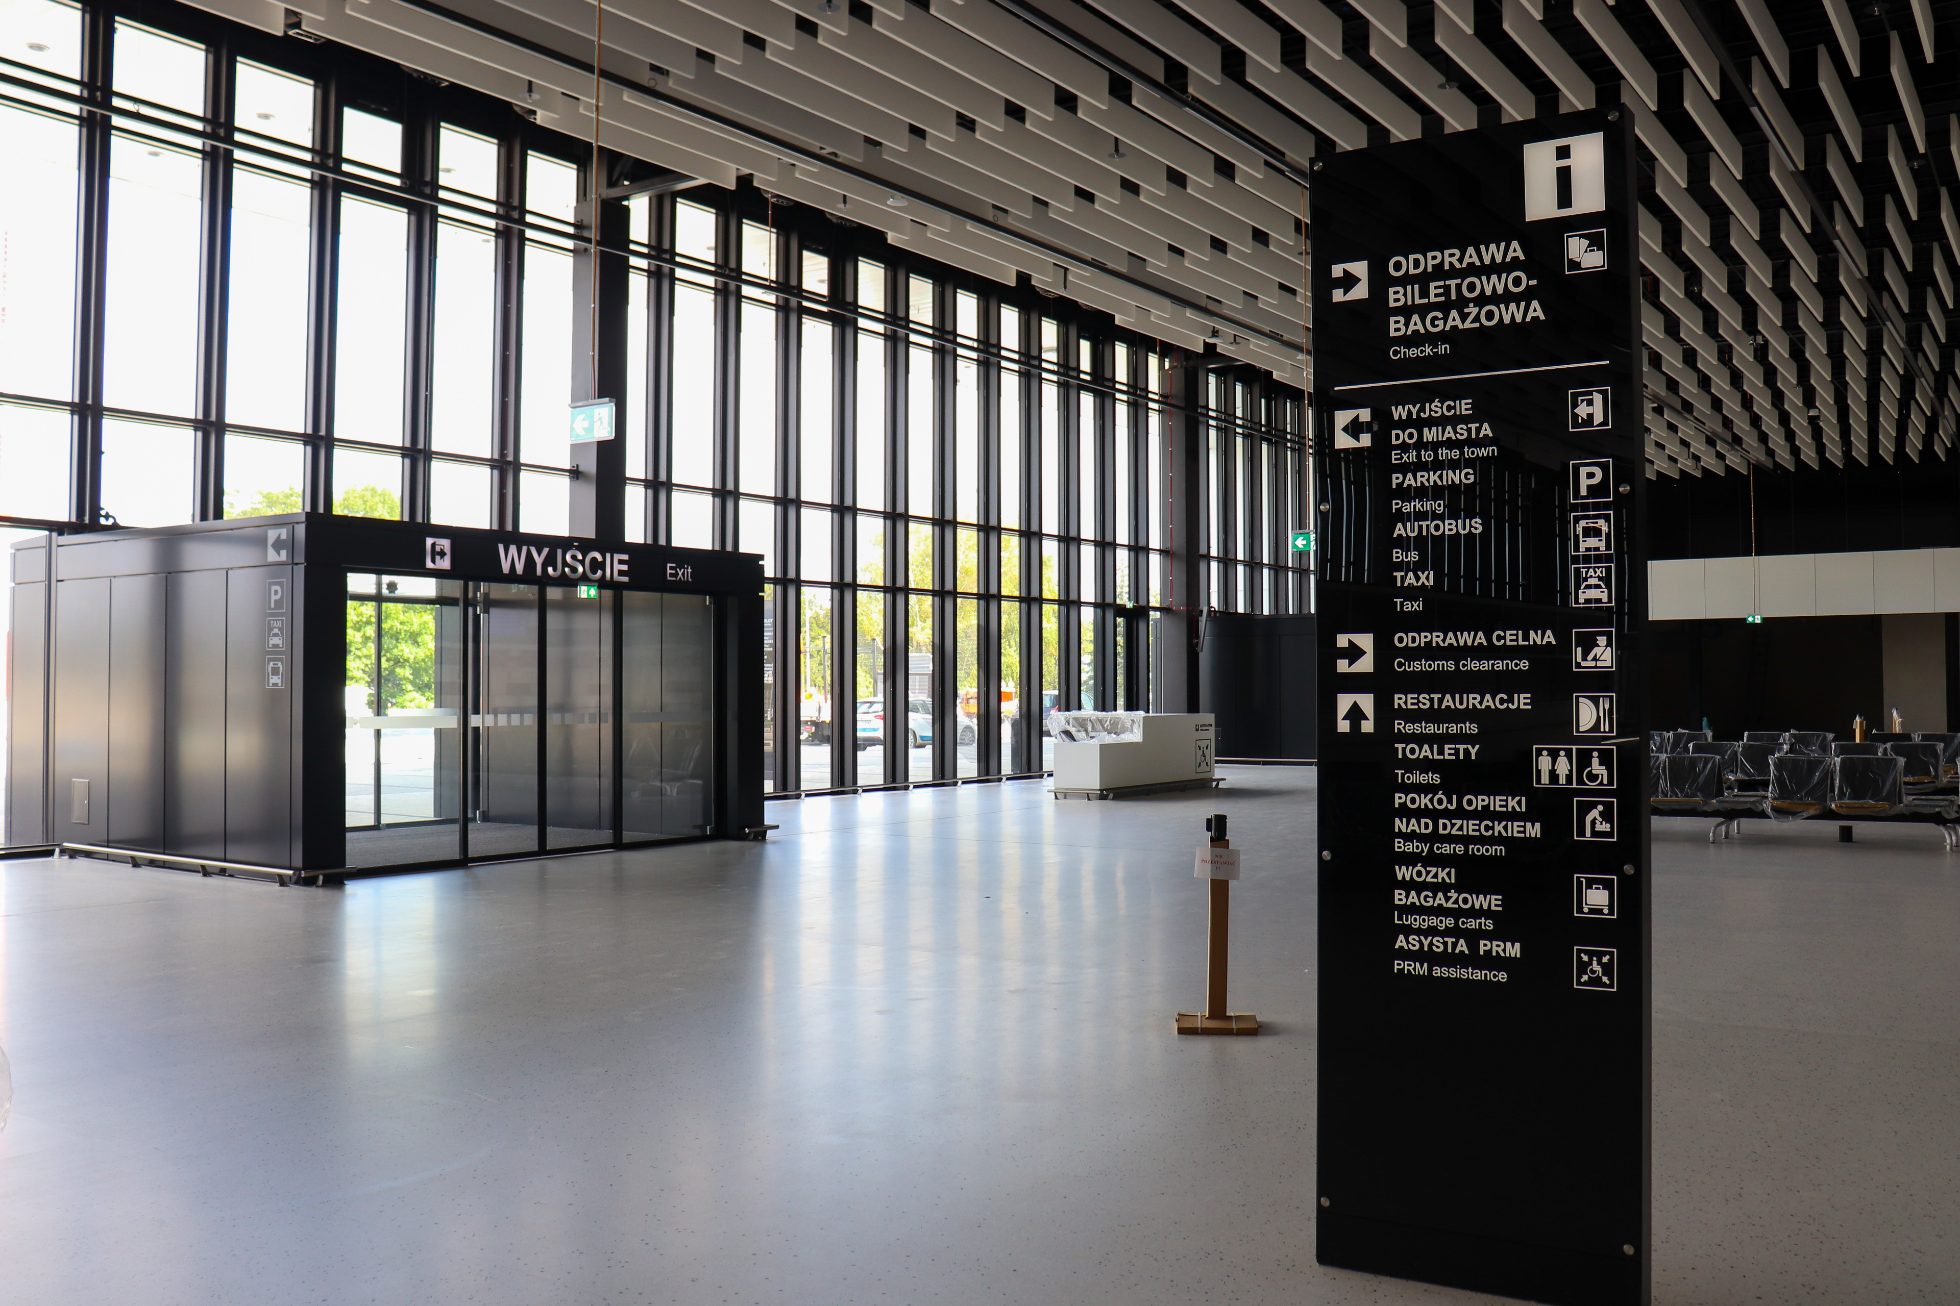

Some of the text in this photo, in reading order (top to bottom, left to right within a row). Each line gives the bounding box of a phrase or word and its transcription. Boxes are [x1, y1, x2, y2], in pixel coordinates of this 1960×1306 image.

[1389, 241, 1525, 277] ODPRAWA
[1389, 271, 1537, 307] BILETOWO-
[1389, 300, 1545, 336] BAGAŻOWA
[1390, 342, 1450, 359] Check-in
[1392, 399, 1472, 420] WYJŚCIE
[1392, 423, 1493, 444] DO MIASTA
[1392, 445, 1497, 463] Exit to the town
[1392, 469, 1475, 488] PARKING
[1580, 466, 1602, 496] P
[1393, 499, 1444, 513] Parking
[1393, 518, 1483, 537] AUTOBUS
[498, 542, 630, 583] WYJŚCIE
[1393, 549, 1418, 562] Bus
[666, 563, 692, 582] Exit
[1393, 571, 1434, 587] TAXI
[1581, 568, 1605, 577] TAXI
[270, 586, 282, 608] P
[1394, 599, 1423, 612] Taxi
[270, 620, 281, 628] TAXI
[1394, 630, 1556, 647] ODPRAWA CELNA
[1394, 658, 1529, 671] Customs clearance
[1394, 694, 1531, 709] RESTAURACJE
[1394, 720, 1478, 734] Restaurants
[1395, 744, 1479, 759] TOALETY
[1395, 770, 1440, 784] Toilets
[1394, 791, 1526, 811] POKÓJ OPIEKI
[1394, 818, 1541, 838] NAD DZIECKIEM
[1394, 839, 1505, 856] Baby care room
[1395, 864, 1455, 883] WÓZKI
[1394, 890, 1502, 910] BAGAŻOWE
[1394, 911, 1493, 929] Luggage carts
[1395, 934, 1520, 957] ASYSTA PRM
[1394, 961, 1507, 982] PRM assistance
